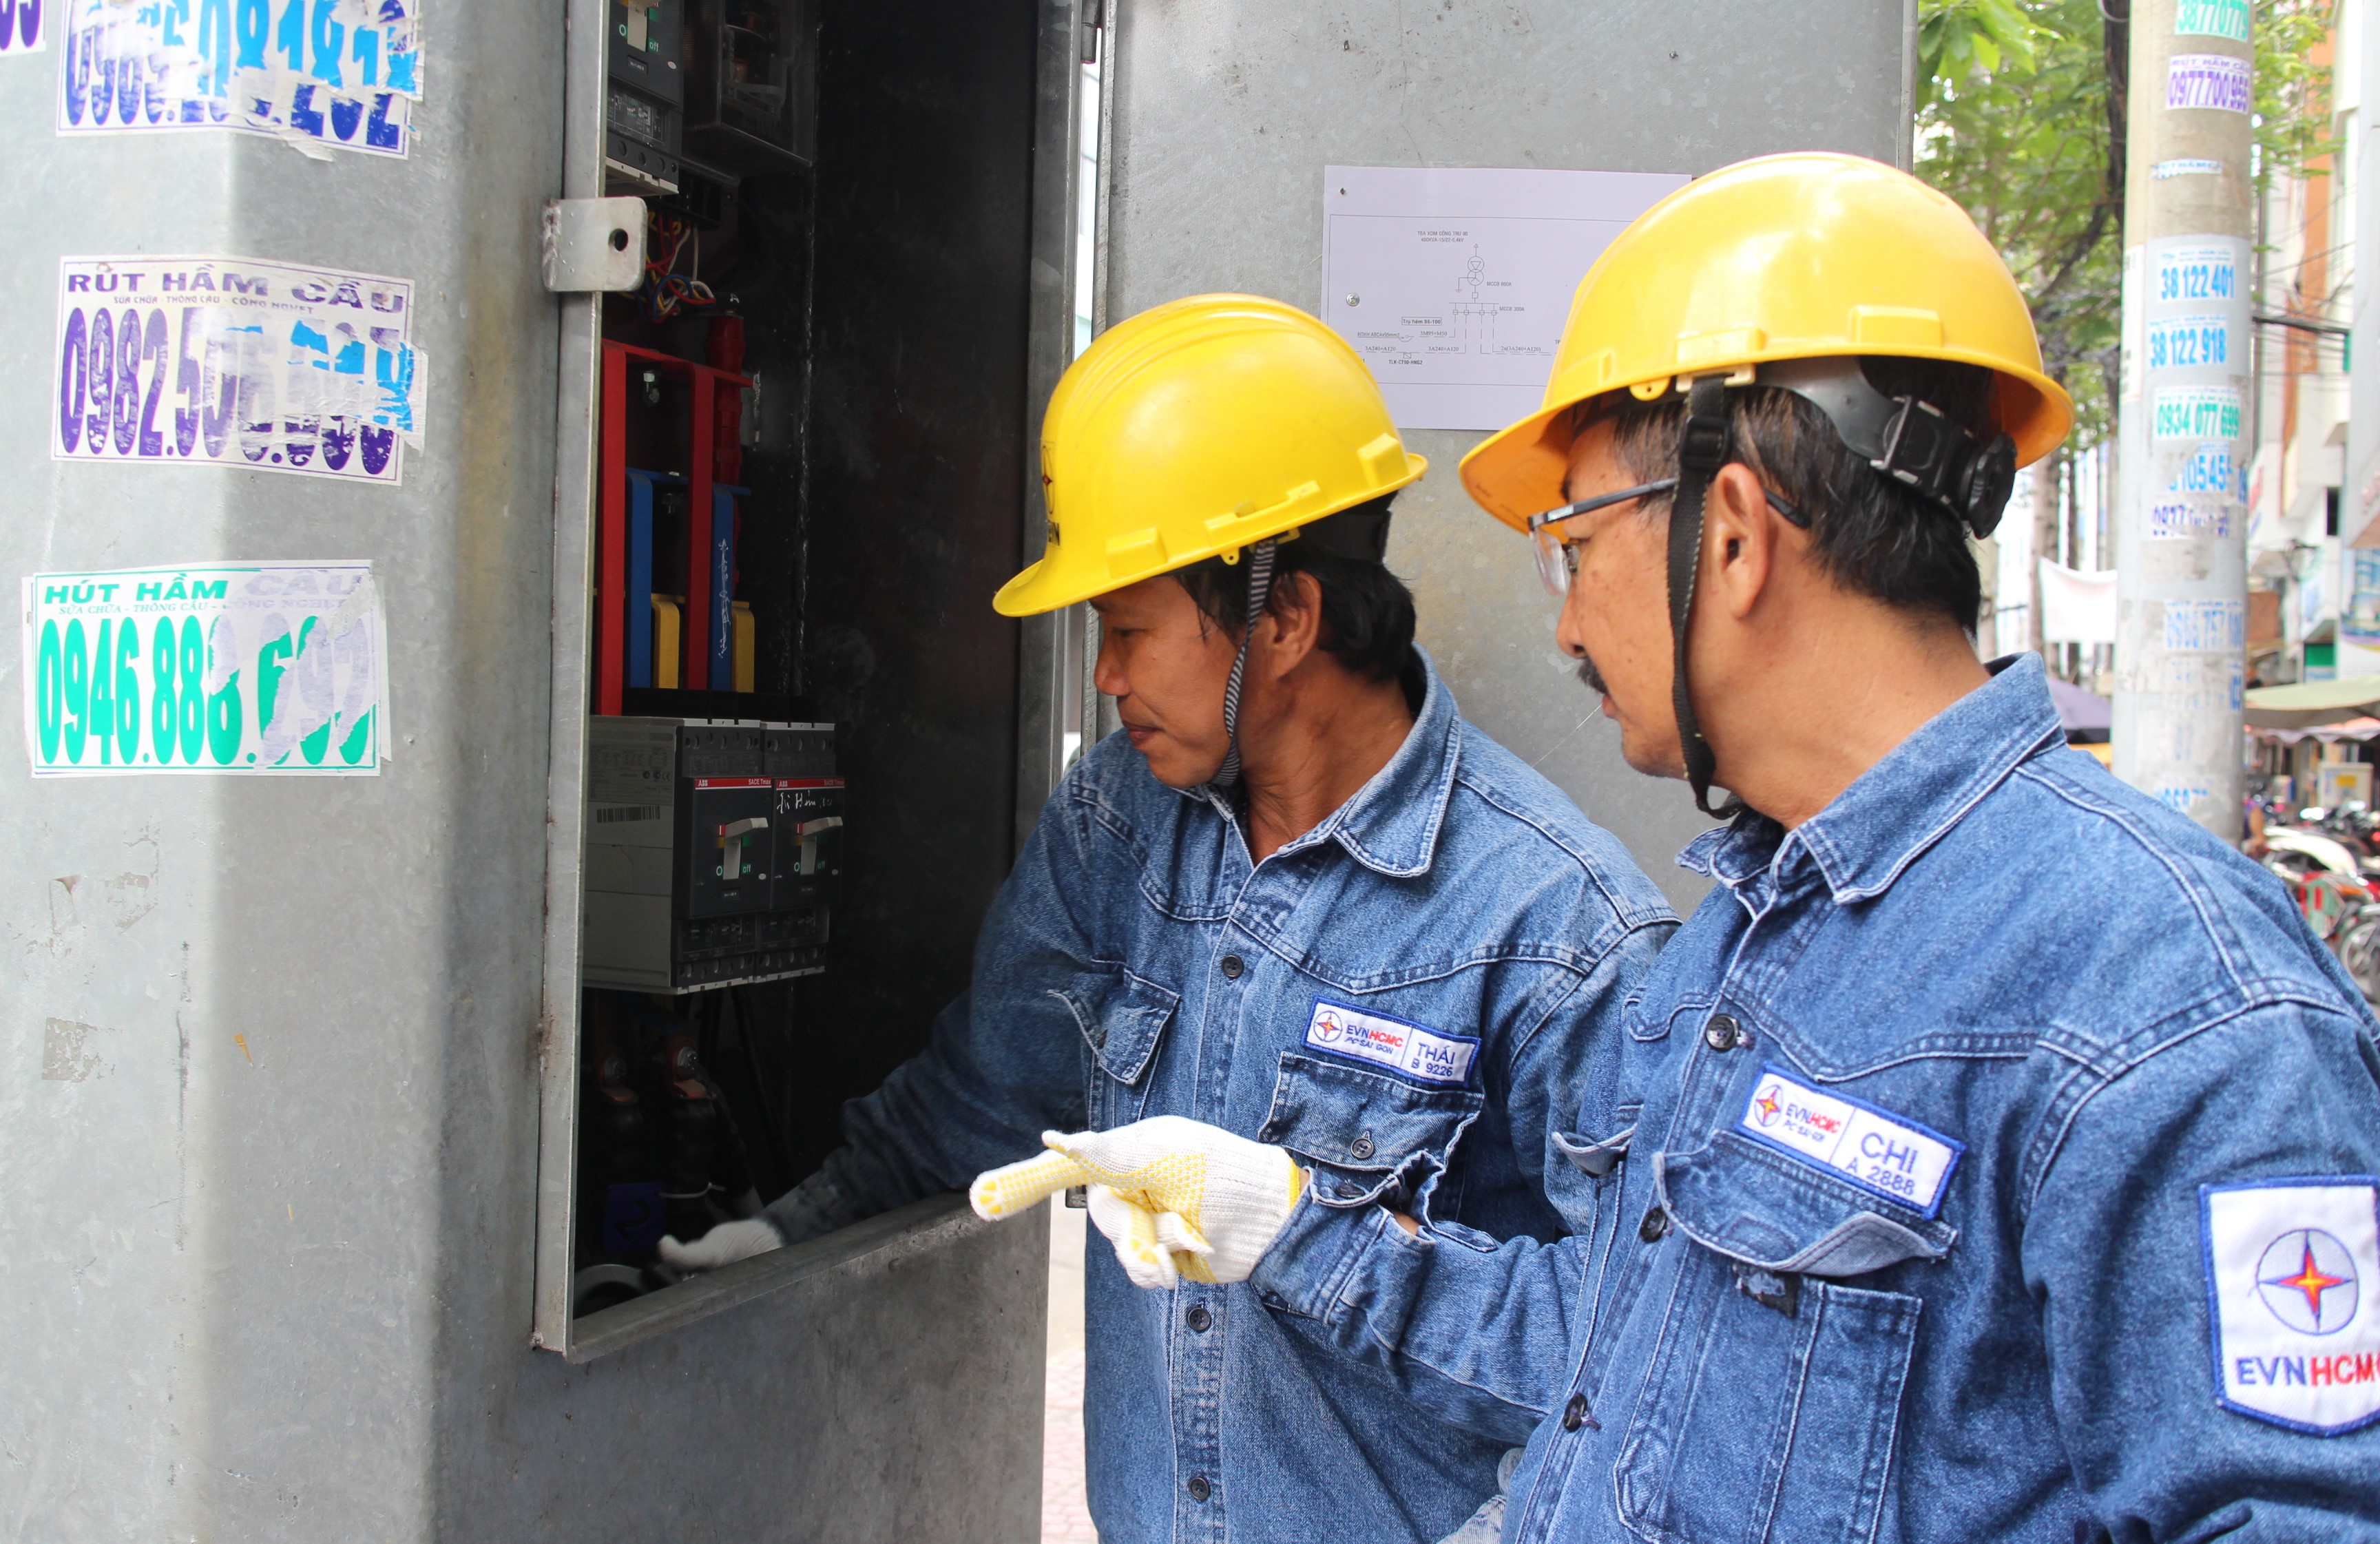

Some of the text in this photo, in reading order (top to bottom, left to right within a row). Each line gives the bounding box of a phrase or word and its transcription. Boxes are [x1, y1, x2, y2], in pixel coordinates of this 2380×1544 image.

[649, 41, 659, 52] off
[162, 264, 269, 297] HẦM
[2161, 264, 2235, 300] 38 122 401
[2171, 328, 2198, 367] 122
[2202, 327, 2226, 364] 918
[44, 579, 120, 605] HÚT
[136, 572, 229, 601] HẦM
[134, 601, 176, 613] THÔNG
[698, 778, 708, 786] ABB
[742, 863, 751, 873] off
[817, 860, 826, 870] off
[1346, 1023, 1403, 1047] EVNHCMC
[1418, 1041, 1457, 1065] THÁI
[1426, 1063, 1453, 1076] 9226
[1861, 1131, 1919, 1174] CHI
[1846, 1156, 1915, 1196] A 2888
